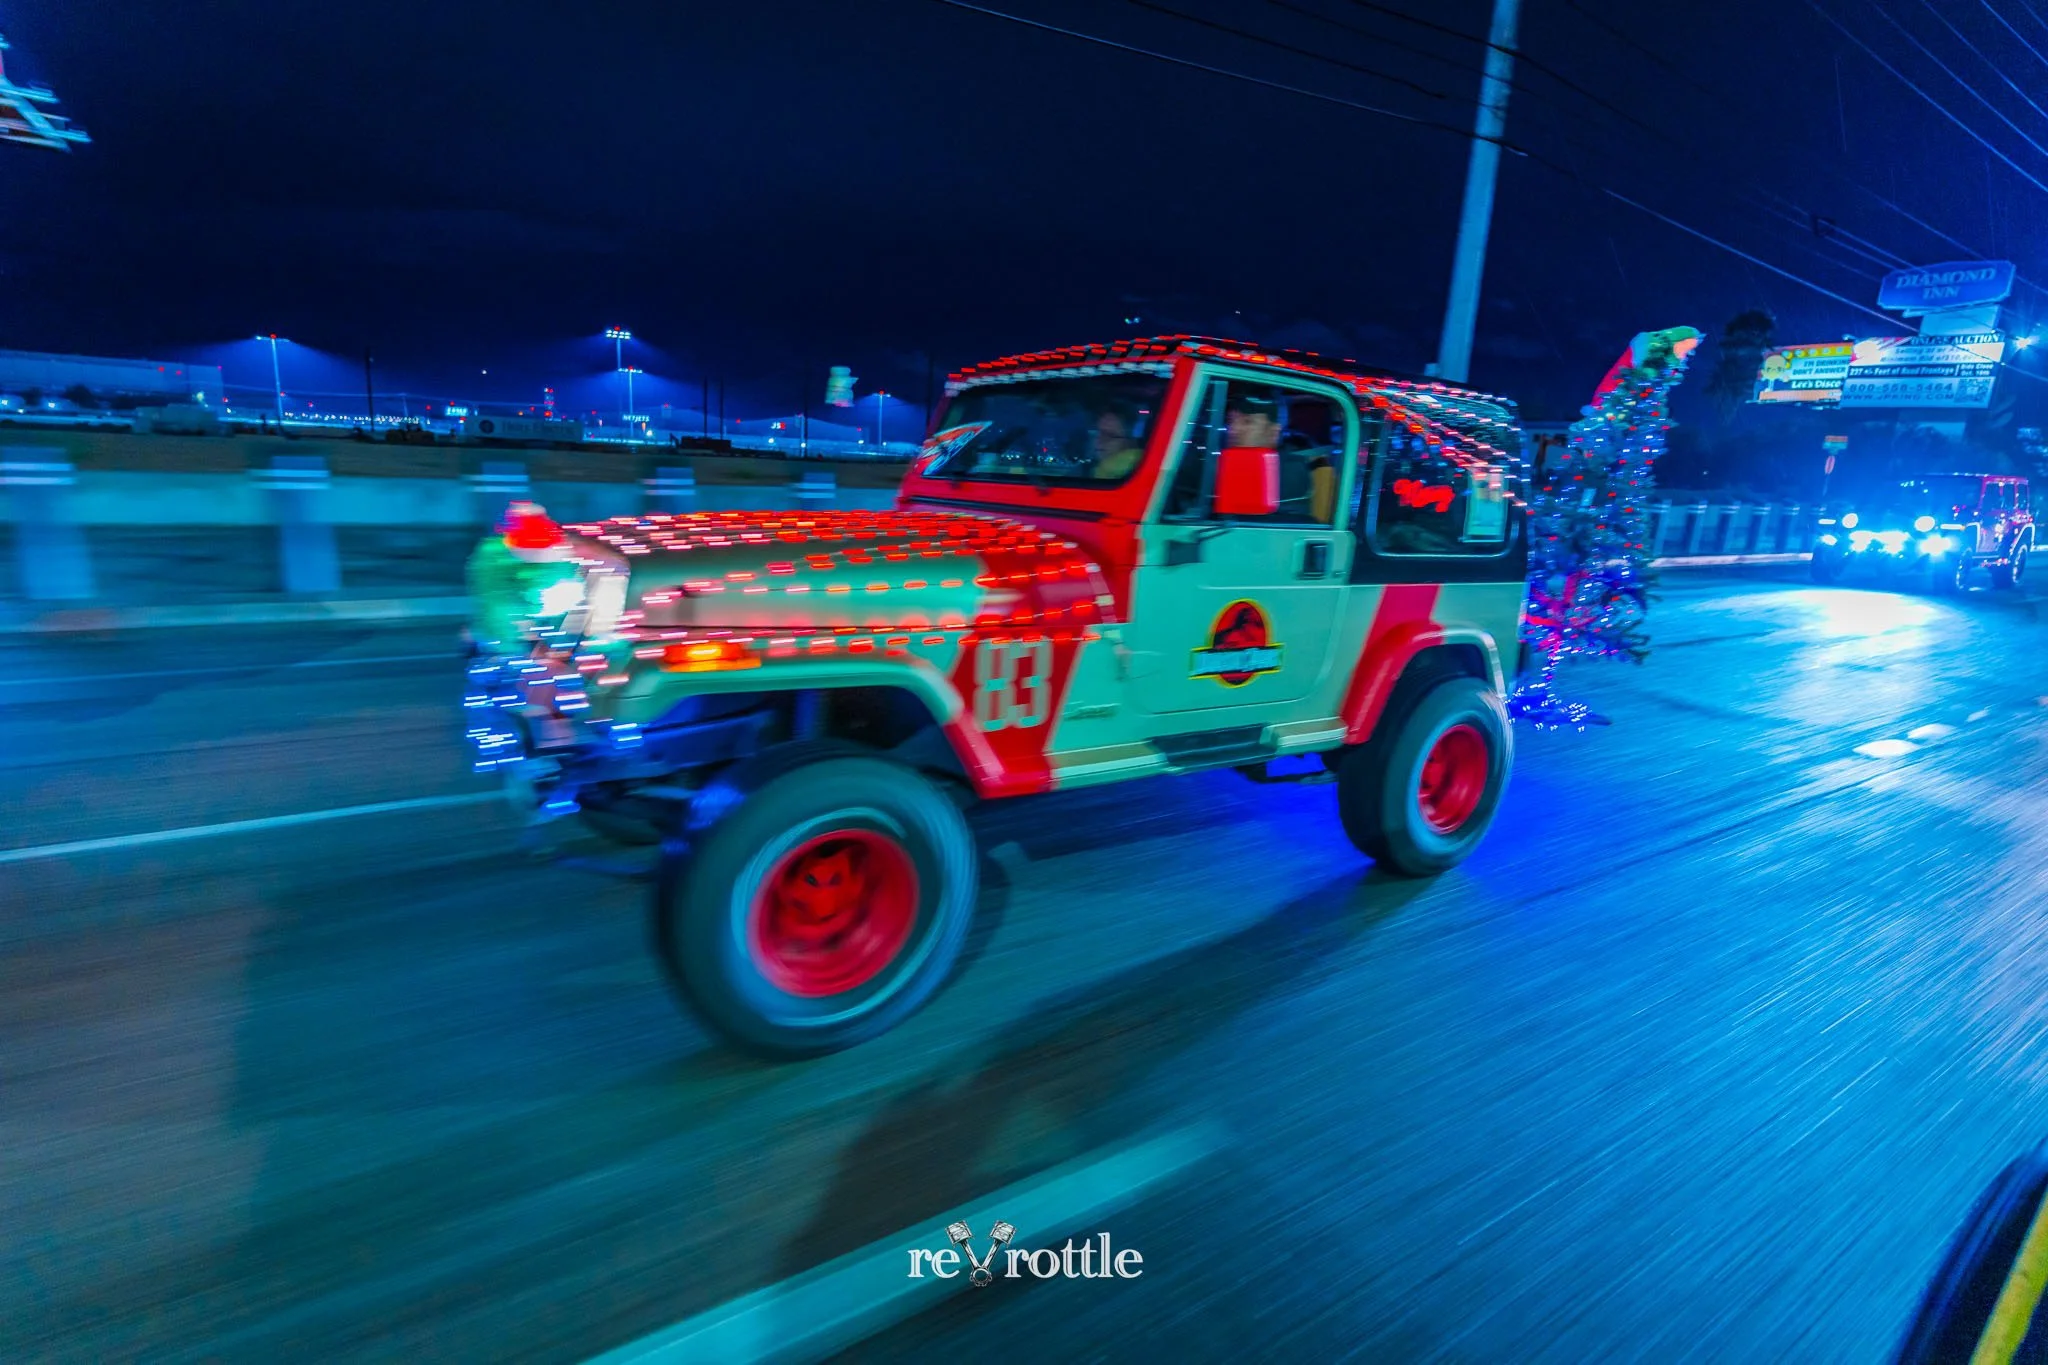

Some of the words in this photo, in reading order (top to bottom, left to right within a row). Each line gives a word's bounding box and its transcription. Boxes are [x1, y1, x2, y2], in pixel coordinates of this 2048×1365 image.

[1897, 268, 1995, 288] DIAMOND
[1924, 286, 1959, 299] INN
[1953, 335, 1999, 344] AUCTION
[1873, 367, 1890, 376] Feet
[1920, 366, 1955, 376] Frontage
[1791, 380, 1813, 389] Lee's
[974, 637, 1053, 732] 83
